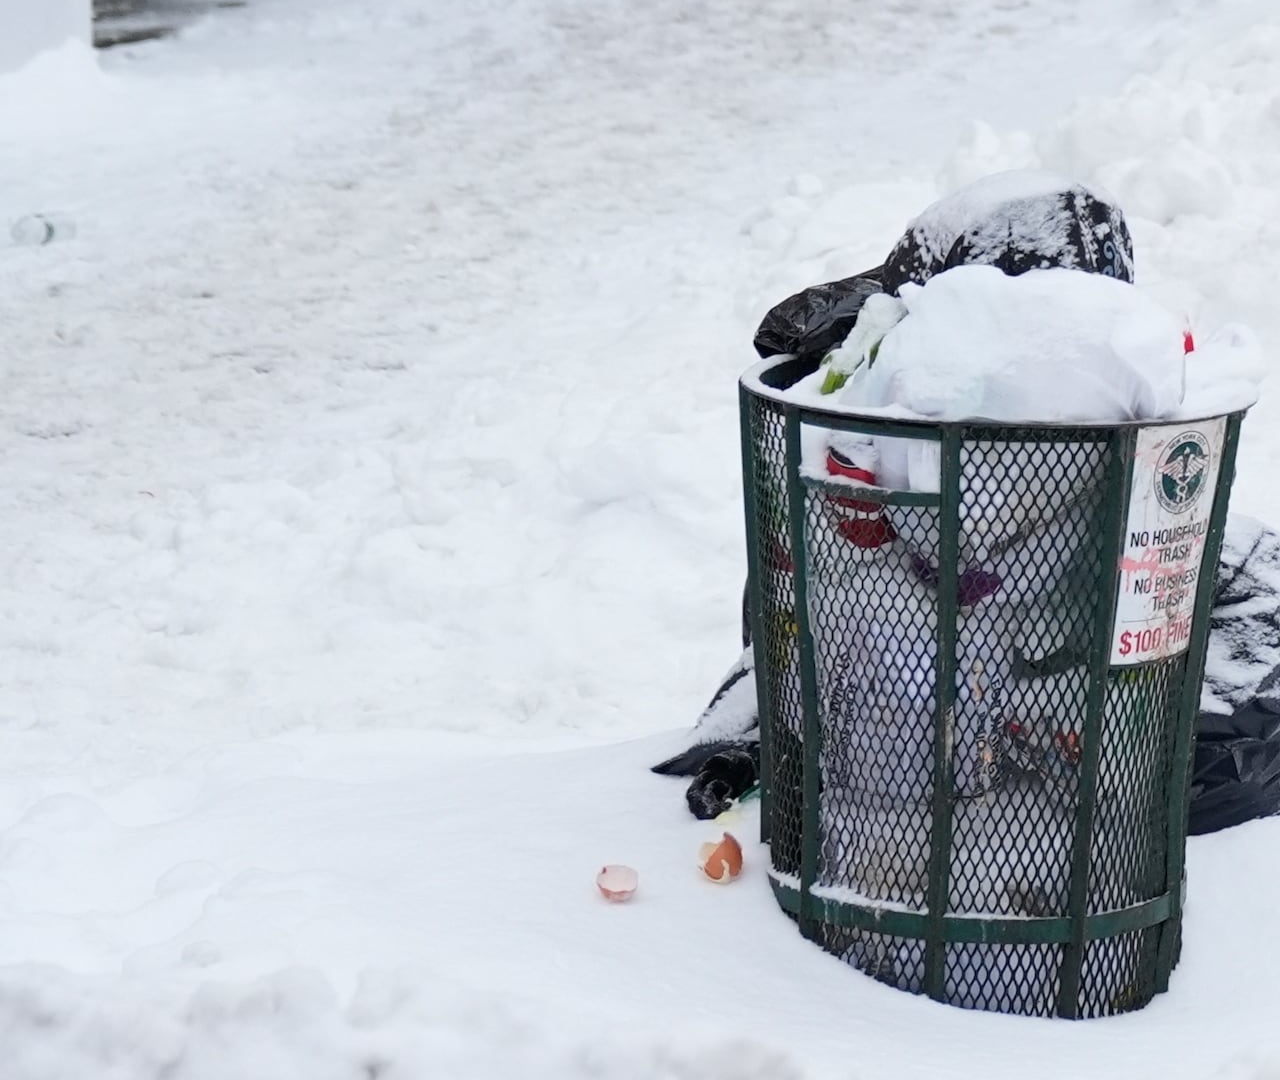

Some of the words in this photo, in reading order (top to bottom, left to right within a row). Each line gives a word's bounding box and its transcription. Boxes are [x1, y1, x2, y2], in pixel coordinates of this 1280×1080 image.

[1130, 531, 1149, 548] NO
[1158, 543, 1192, 564] TRASH
[1134, 577, 1152, 595] NO
[1118, 627, 1162, 658] $100
